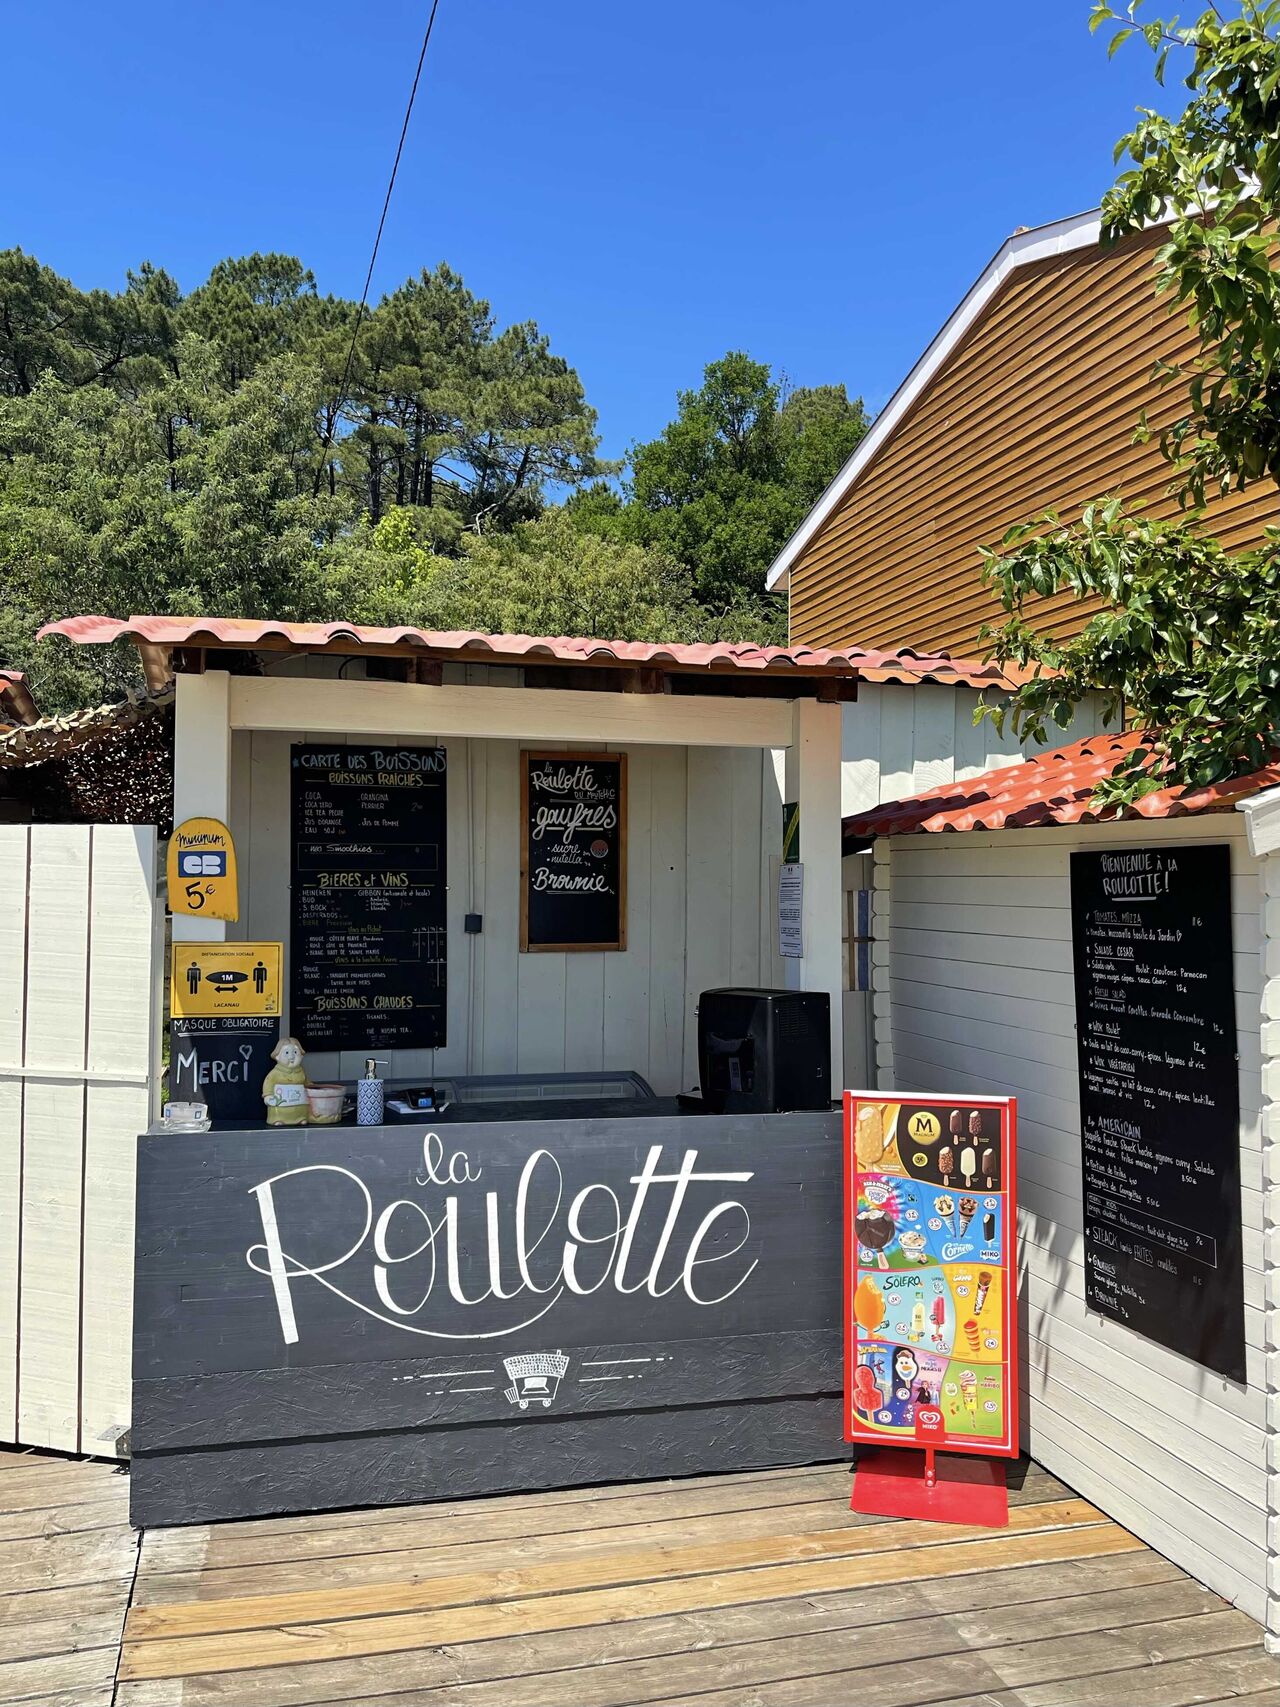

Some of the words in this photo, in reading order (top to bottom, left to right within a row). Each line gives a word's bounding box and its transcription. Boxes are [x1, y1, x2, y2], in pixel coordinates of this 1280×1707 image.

[301, 754, 340, 768] CARTE
[348, 755, 367, 769] DES
[530, 765, 598, 794] Roulotte
[305, 792, 321, 800] COCA
[360, 793, 389, 801] ORANGINA
[326, 844, 372, 853] Smoothies
[551, 844, 580, 853] sucre
[183, 855, 221, 875] CB
[551, 853, 583, 864] nutella
[1168, 858, 1178, 872] LA
[364, 874, 375, 886] et
[533, 867, 609, 892] Brownie
[185, 881, 216, 910] 5€
[373, 995, 414, 1008] CHAUDES
[174, 1019, 217, 1032] MASQUE
[221, 1018, 274, 1029] OBLIGATOIRE
[916, 1117, 933, 1132] M
[416, 1132, 482, 1186] la
[1093, 1226, 1118, 1247] STEACK
[246, 1144, 758, 1345] Roulotte
[981, 1250, 999, 1258] MIKO
[882, 1275, 920, 1290] SOLERO
